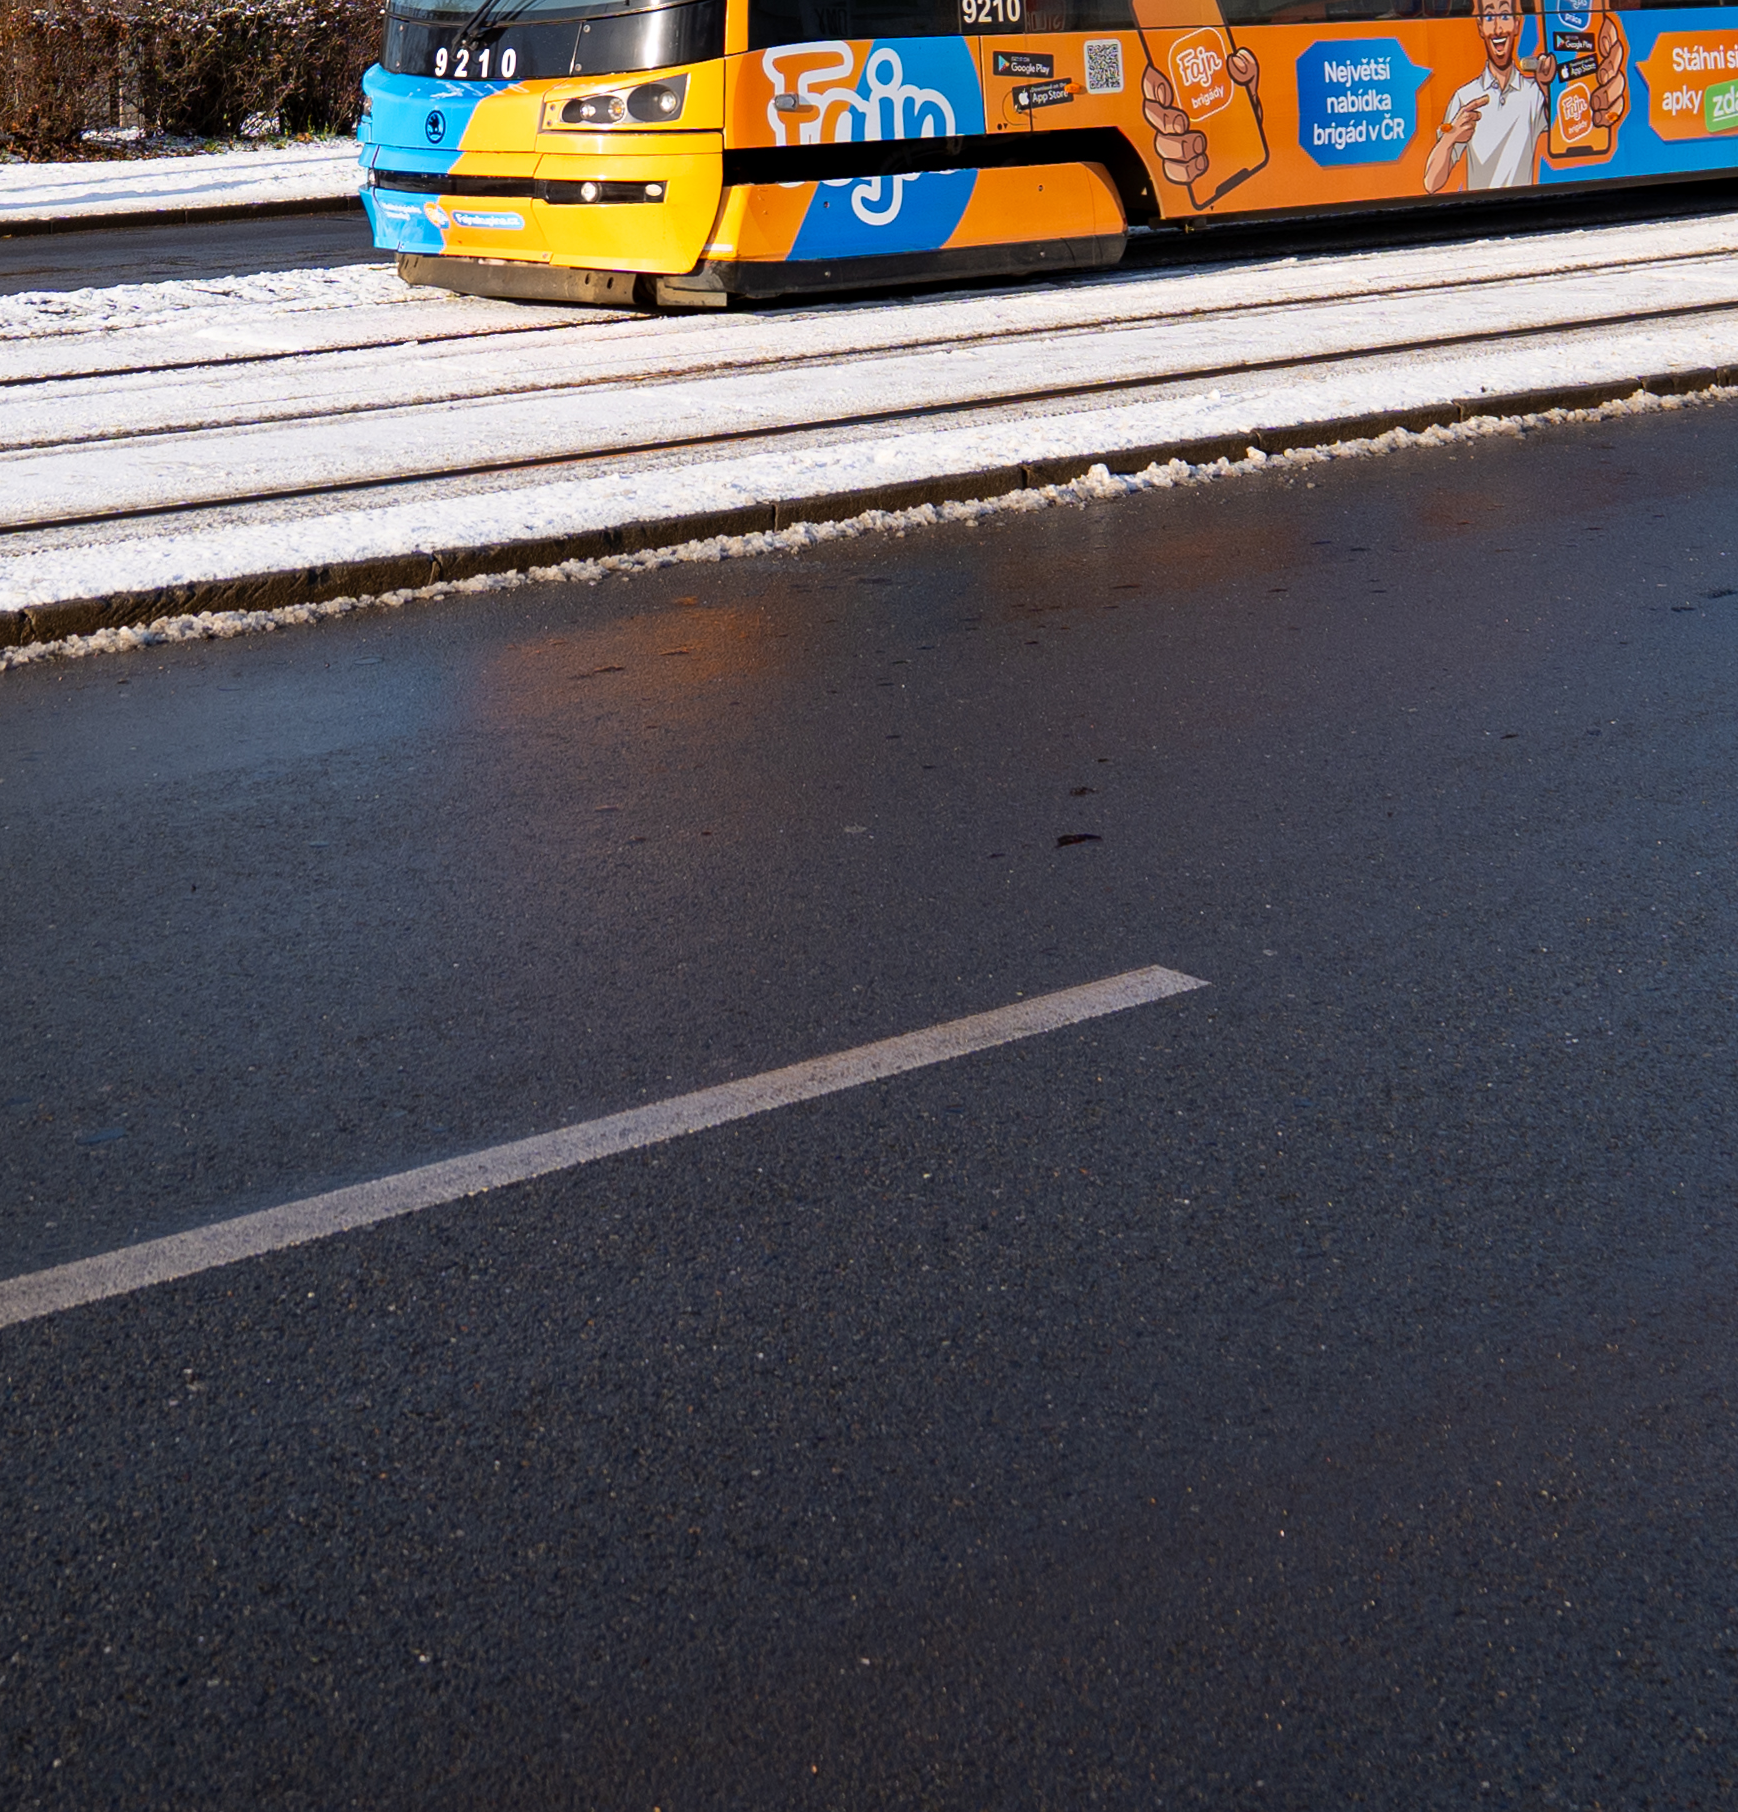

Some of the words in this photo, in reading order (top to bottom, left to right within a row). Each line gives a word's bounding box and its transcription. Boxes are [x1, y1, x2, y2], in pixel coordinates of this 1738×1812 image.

[435, 47, 517, 78] 9210
[1011, 62, 1036, 75] Google
[1035, 63, 1050, 75] Play
[1176, 46, 1223, 87] Fajn
[1324, 56, 1391, 87] Největší
[1672, 47, 1725, 72] Stáhni
[1032, 92, 1049, 104] App
[1191, 85, 1225, 109] brigády
[1327, 90, 1392, 114] nabídka
[1662, 85, 1702, 116] apky
[762, 40, 957, 227] Fajn
[1313, 120, 1366, 150] brigád
[1367, 126, 1380, 141] v
[1381, 114, 1405, 140] ČR
